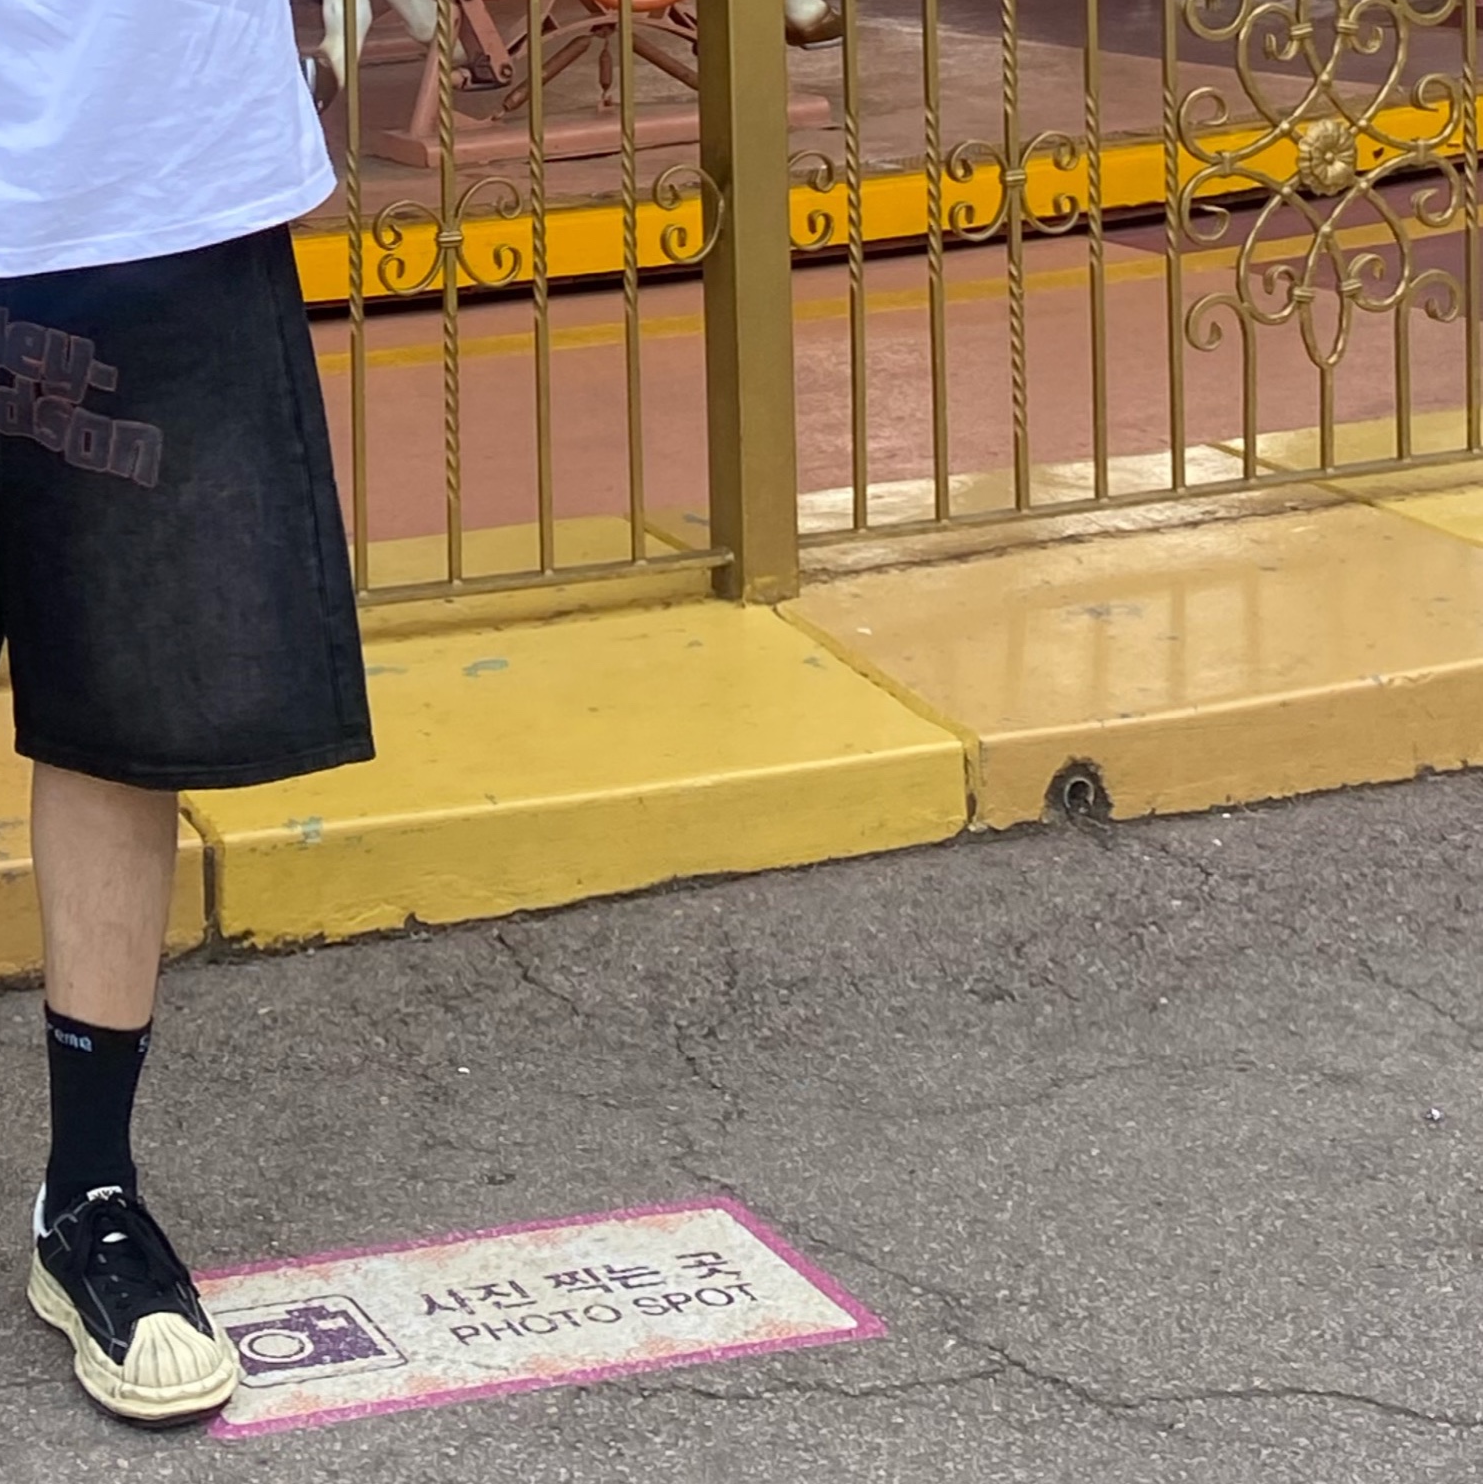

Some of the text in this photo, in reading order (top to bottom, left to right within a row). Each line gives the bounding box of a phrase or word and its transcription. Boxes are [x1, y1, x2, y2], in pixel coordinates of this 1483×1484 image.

[420, 1251, 743, 1316] 사진 찍는 곳
[449, 1282, 759, 1345] PHOTO SPOT
